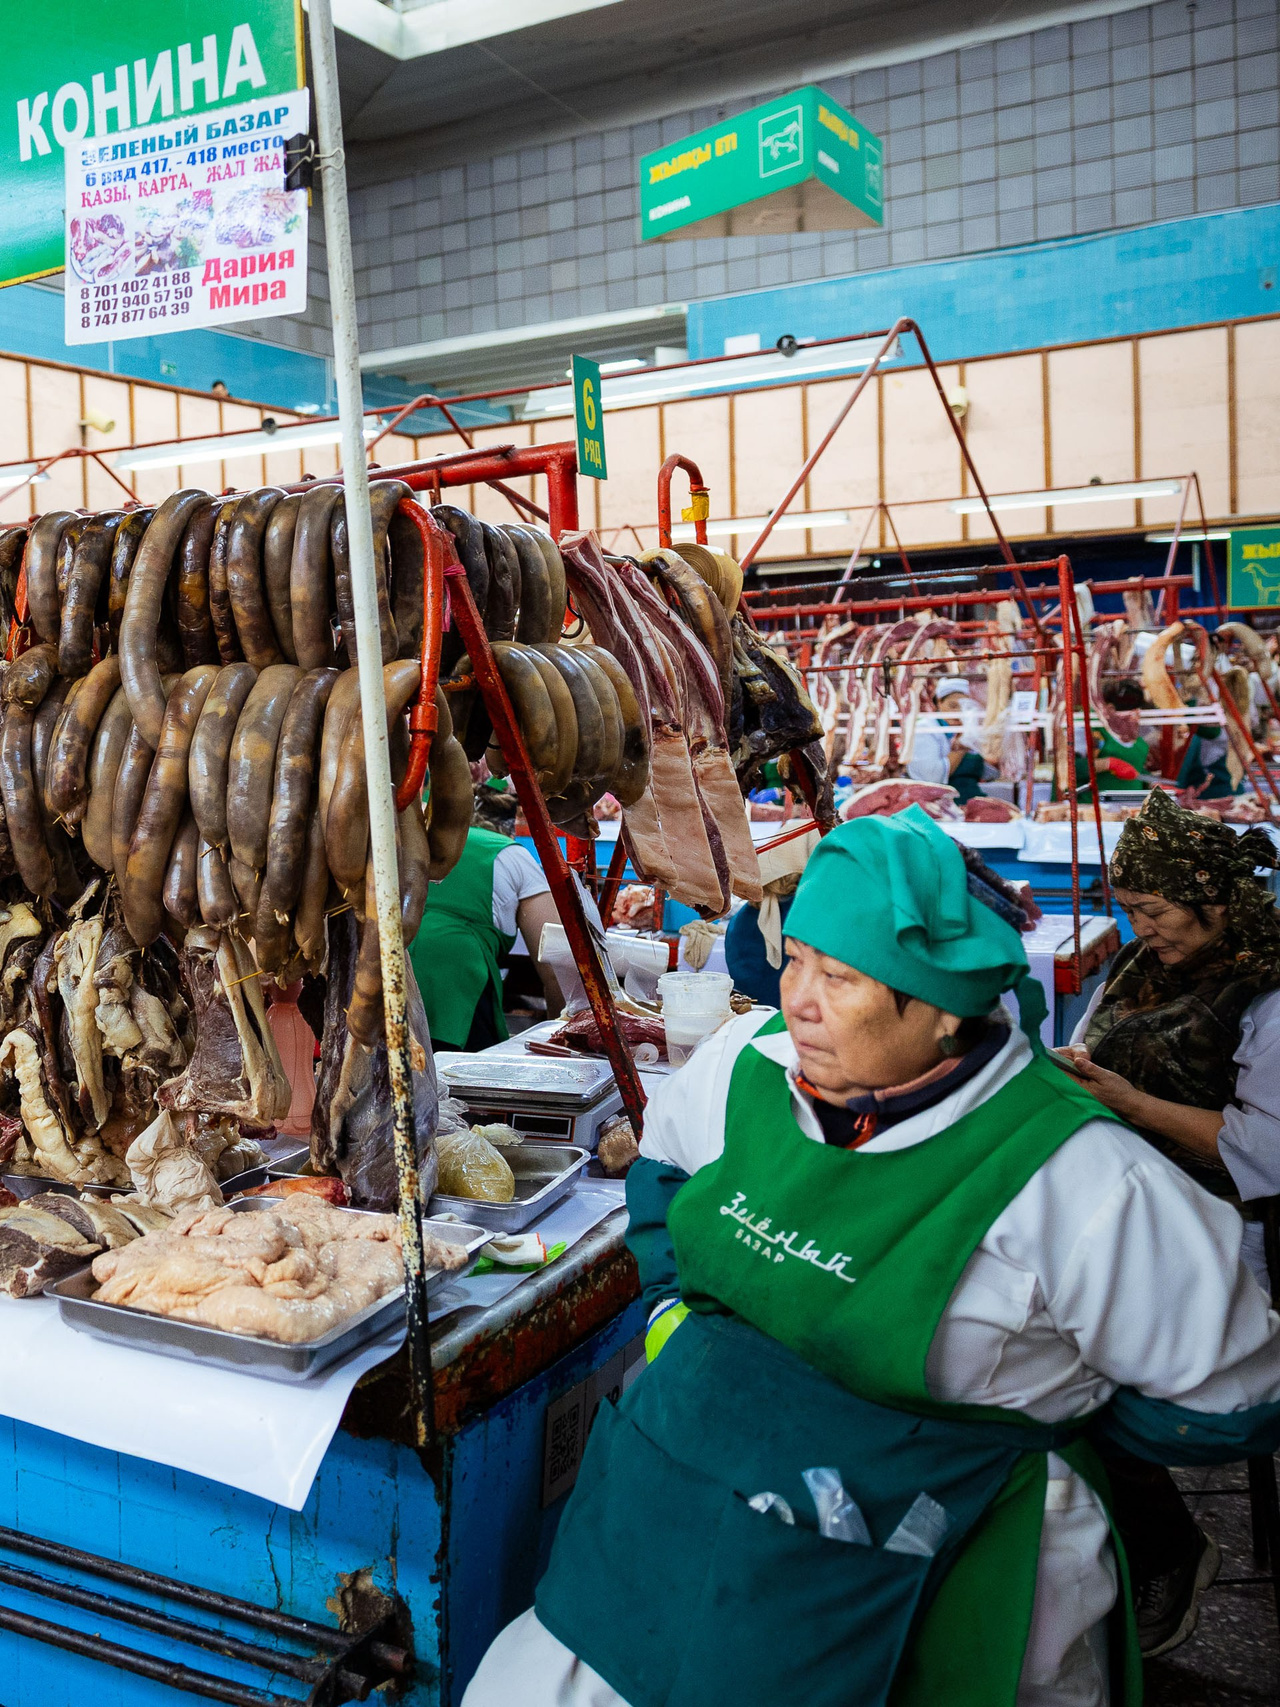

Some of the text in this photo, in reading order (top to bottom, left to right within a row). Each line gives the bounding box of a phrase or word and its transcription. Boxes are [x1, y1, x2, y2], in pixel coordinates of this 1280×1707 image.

[17, 22, 267, 162] КОНИНА
[206, 106, 289, 141] БАЗАР
[85, 171, 97, 187] 6
[187, 146, 217, 166] 418
[222, 134, 284, 156] место
[206, 159, 246, 183] ЖАЛ
[254, 152, 287, 173] ЖА
[201, 248, 295, 286] Дария
[80, 271, 191, 300] 8 701 402 41 88
[81, 285, 193, 314] 8 707 940 57 50
[209, 279, 287, 310] Мира
[81, 301, 190, 329] 8 747 877 64 39
[583, 378, 596, 431] 6
[583, 437, 603, 470] РЯД
[735, 1228, 786, 1264] БАЗАР
